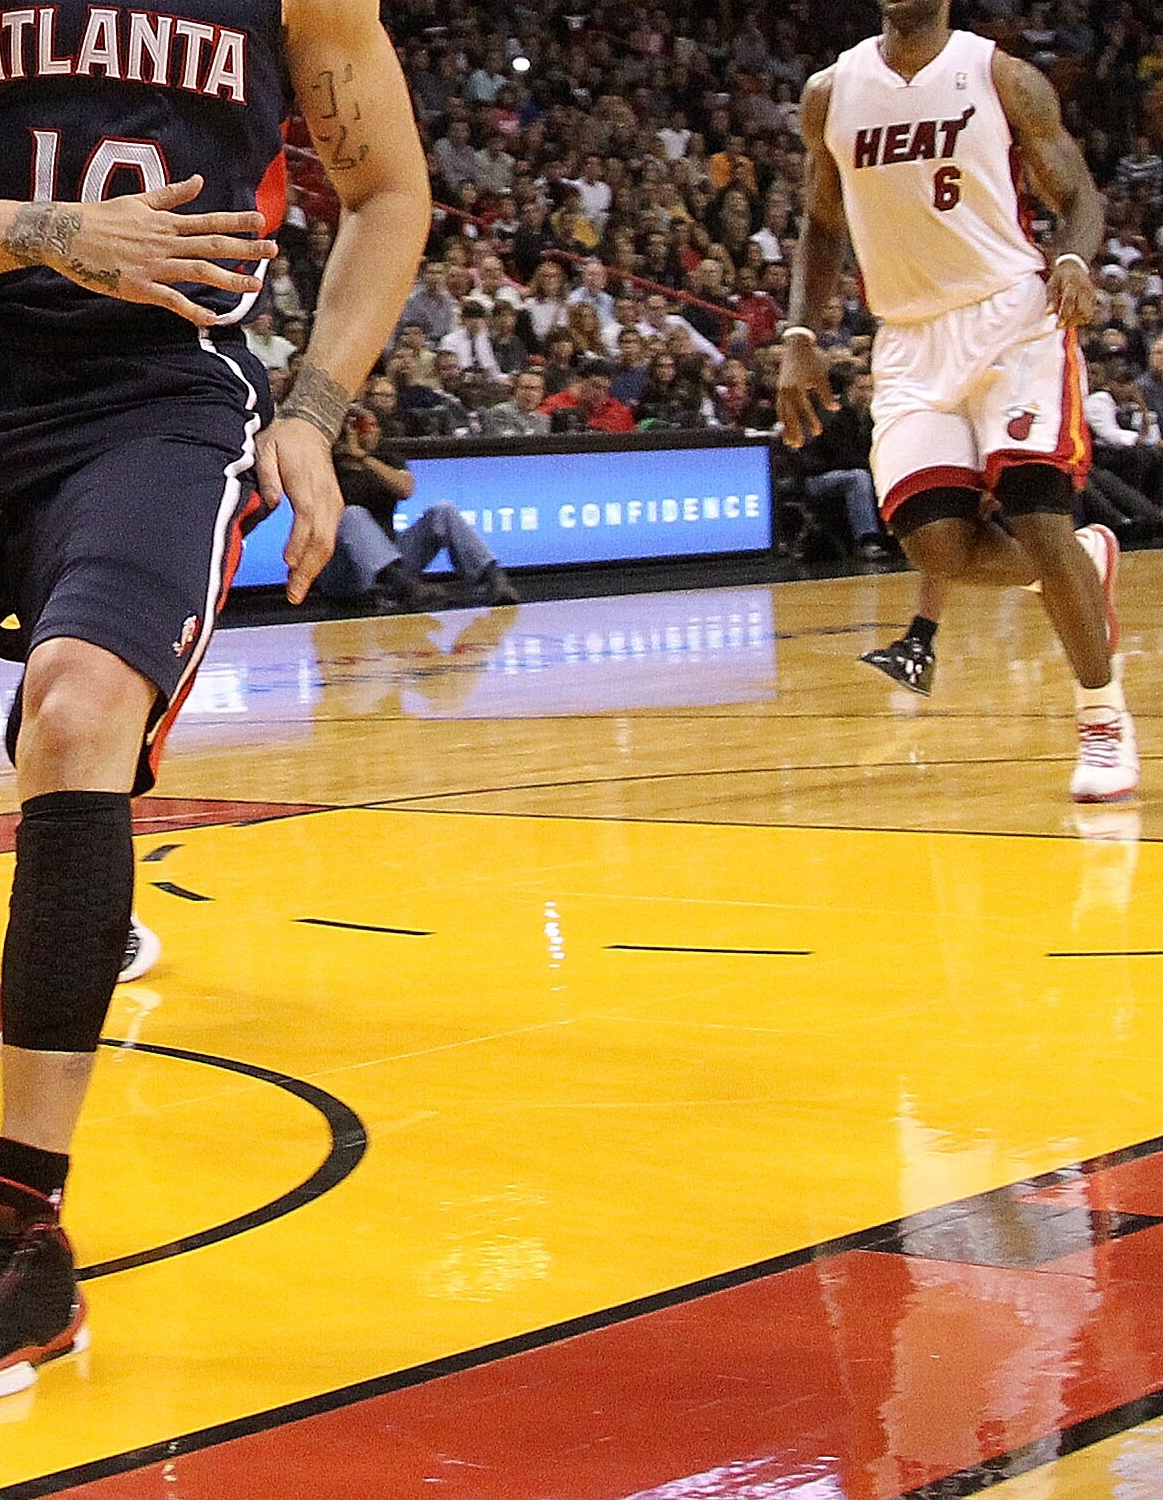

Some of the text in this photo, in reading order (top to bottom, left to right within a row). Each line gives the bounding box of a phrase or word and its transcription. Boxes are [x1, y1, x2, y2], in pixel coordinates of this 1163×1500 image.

[854, 105, 976, 169] HEAT
[933, 165, 962, 213] 6
[558, 494, 760, 529] CONFIDENCE
